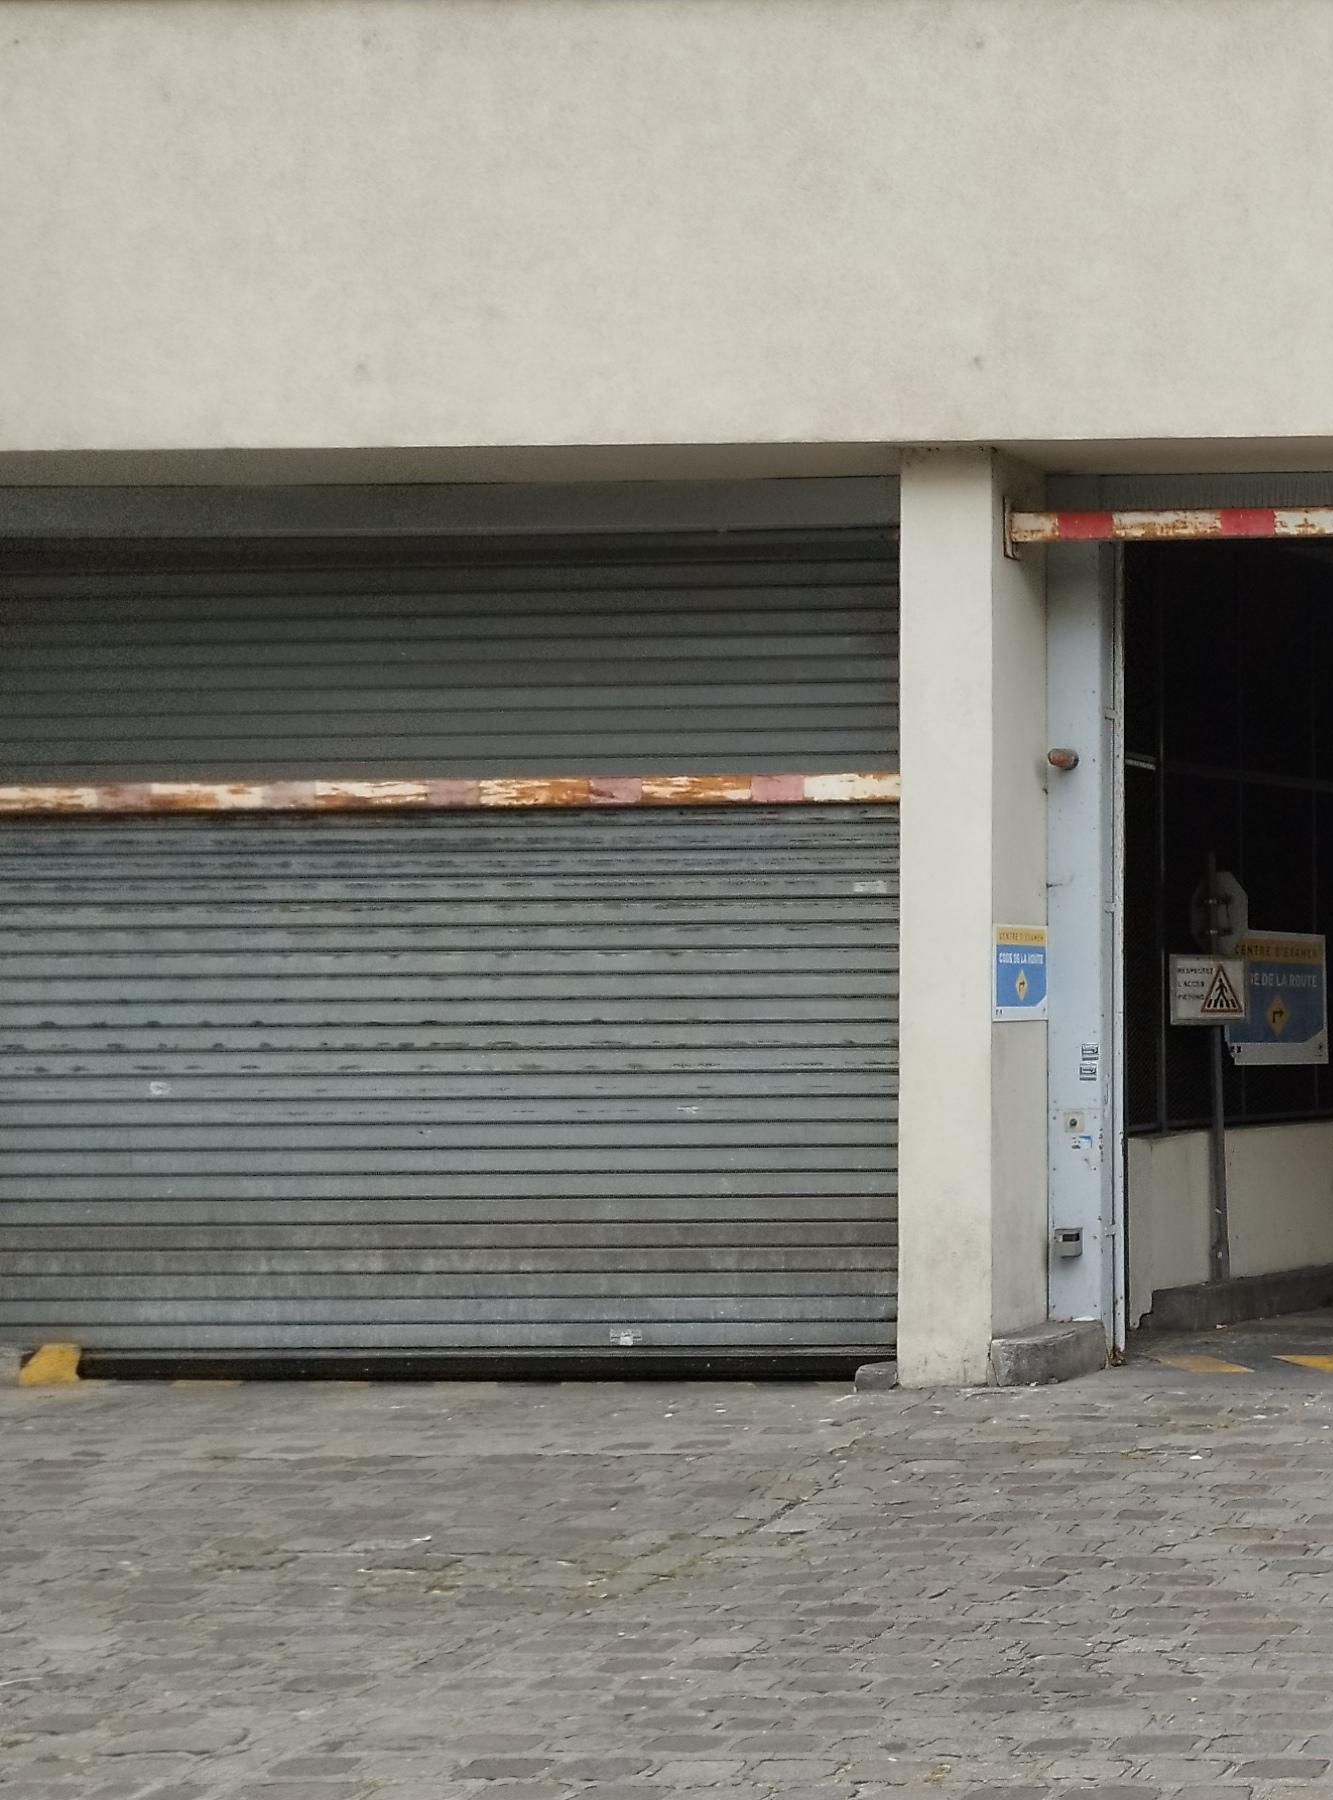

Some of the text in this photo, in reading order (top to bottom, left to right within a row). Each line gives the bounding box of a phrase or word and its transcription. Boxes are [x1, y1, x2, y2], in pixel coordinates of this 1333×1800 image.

[1234, 943, 1271, 956] CENTRE
[1262, 972, 1275, 986] DE
[1276, 973, 1289, 987] LA
[1289, 973, 1318, 988] ROUTE
